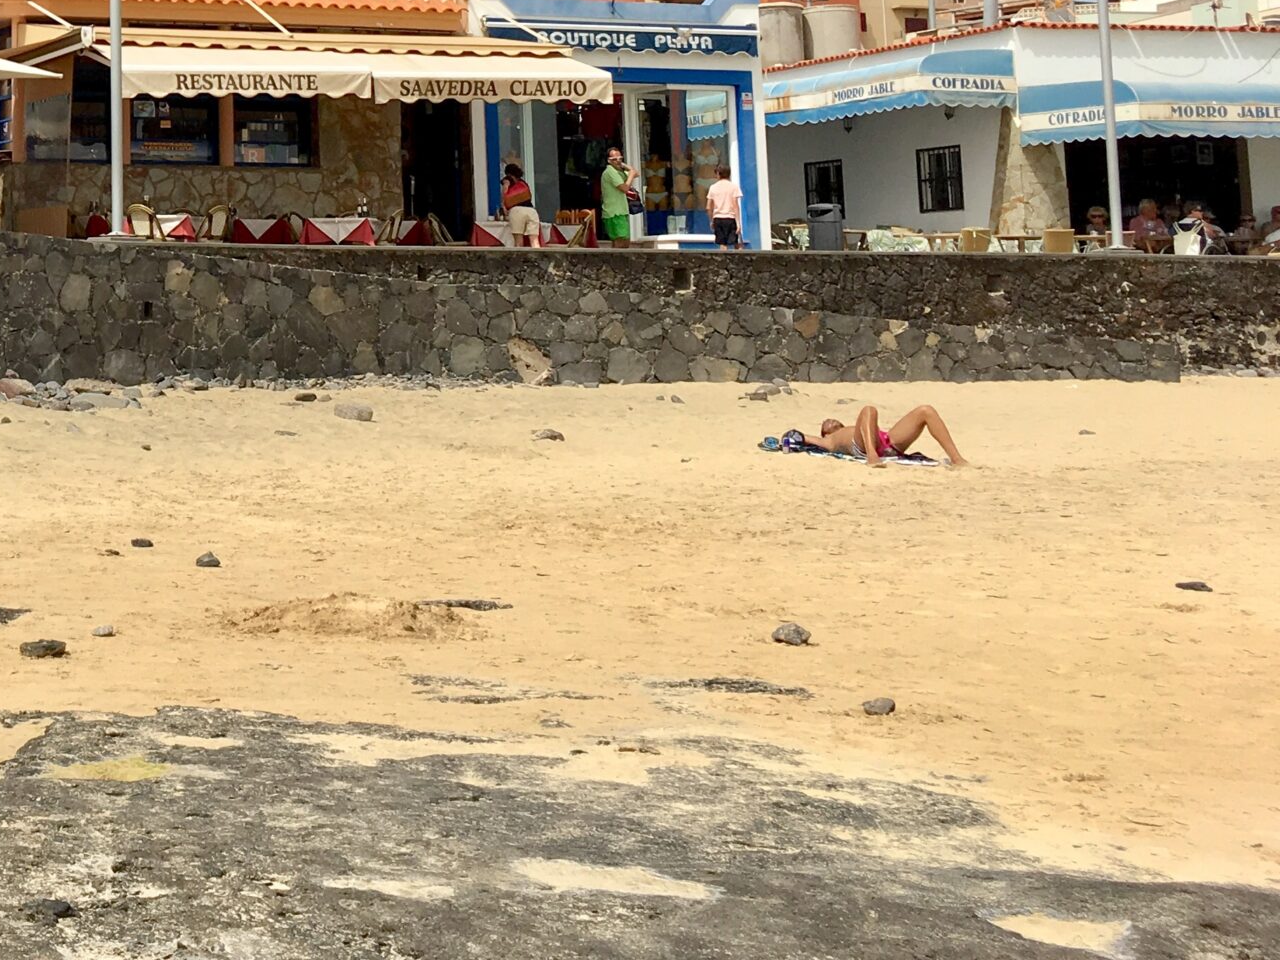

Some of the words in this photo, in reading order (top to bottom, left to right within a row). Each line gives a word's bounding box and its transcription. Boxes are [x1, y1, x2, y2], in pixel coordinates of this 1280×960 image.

[654, 34, 713, 50] PLAYA
[175, 74, 319, 91] RESTAURANTE
[400, 80, 498, 97] SAAVEDRA
[509, 80, 587, 97] CLAVIJO
[833, 86, 865, 101] MORRO
[868, 81, 896, 96] JABLE
[932, 76, 1005, 90] COFRADIA
[1048, 108, 1106, 126] COFRADI
[1170, 105, 1228, 118] MORRO
[1236, 106, 1280, 119] JABLE
